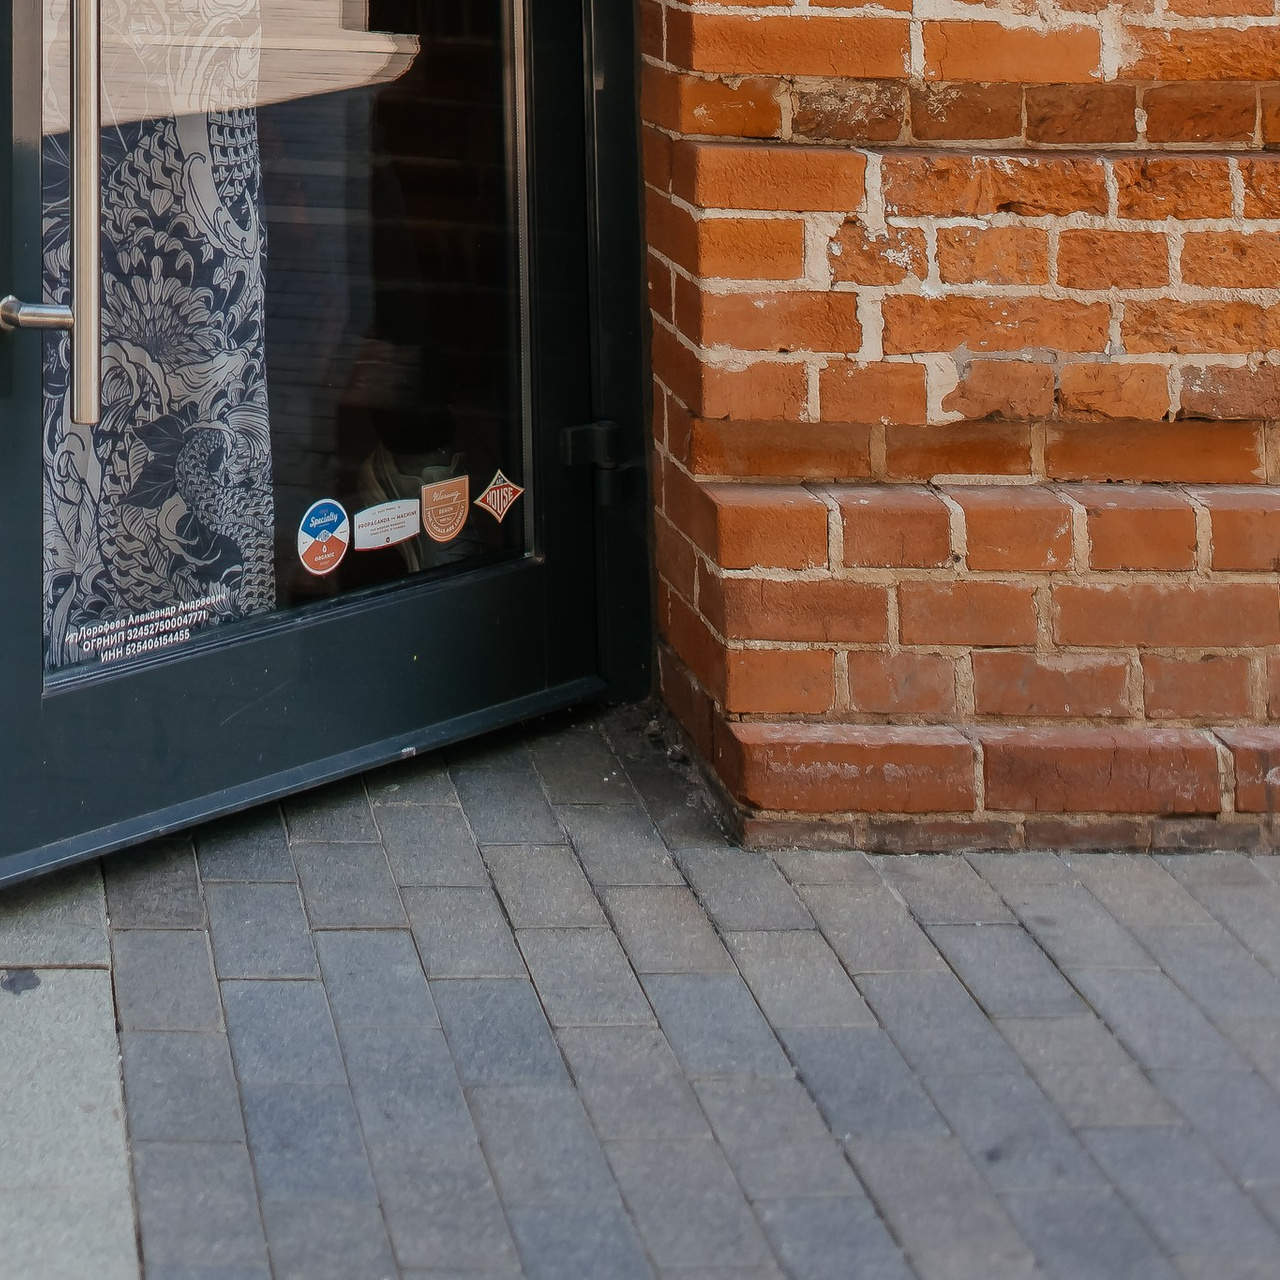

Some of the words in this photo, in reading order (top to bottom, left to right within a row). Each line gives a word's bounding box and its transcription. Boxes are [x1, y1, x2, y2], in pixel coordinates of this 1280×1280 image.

[486, 487, 514, 515] HOUSE
[83, 631, 125, 652] ОГРНИП
[127, 609, 207, 641] 324527500047771
[127, 605, 177, 627] Александр
[101, 646, 123, 663] ИНН
[125, 628, 190, 656] 525406154455
